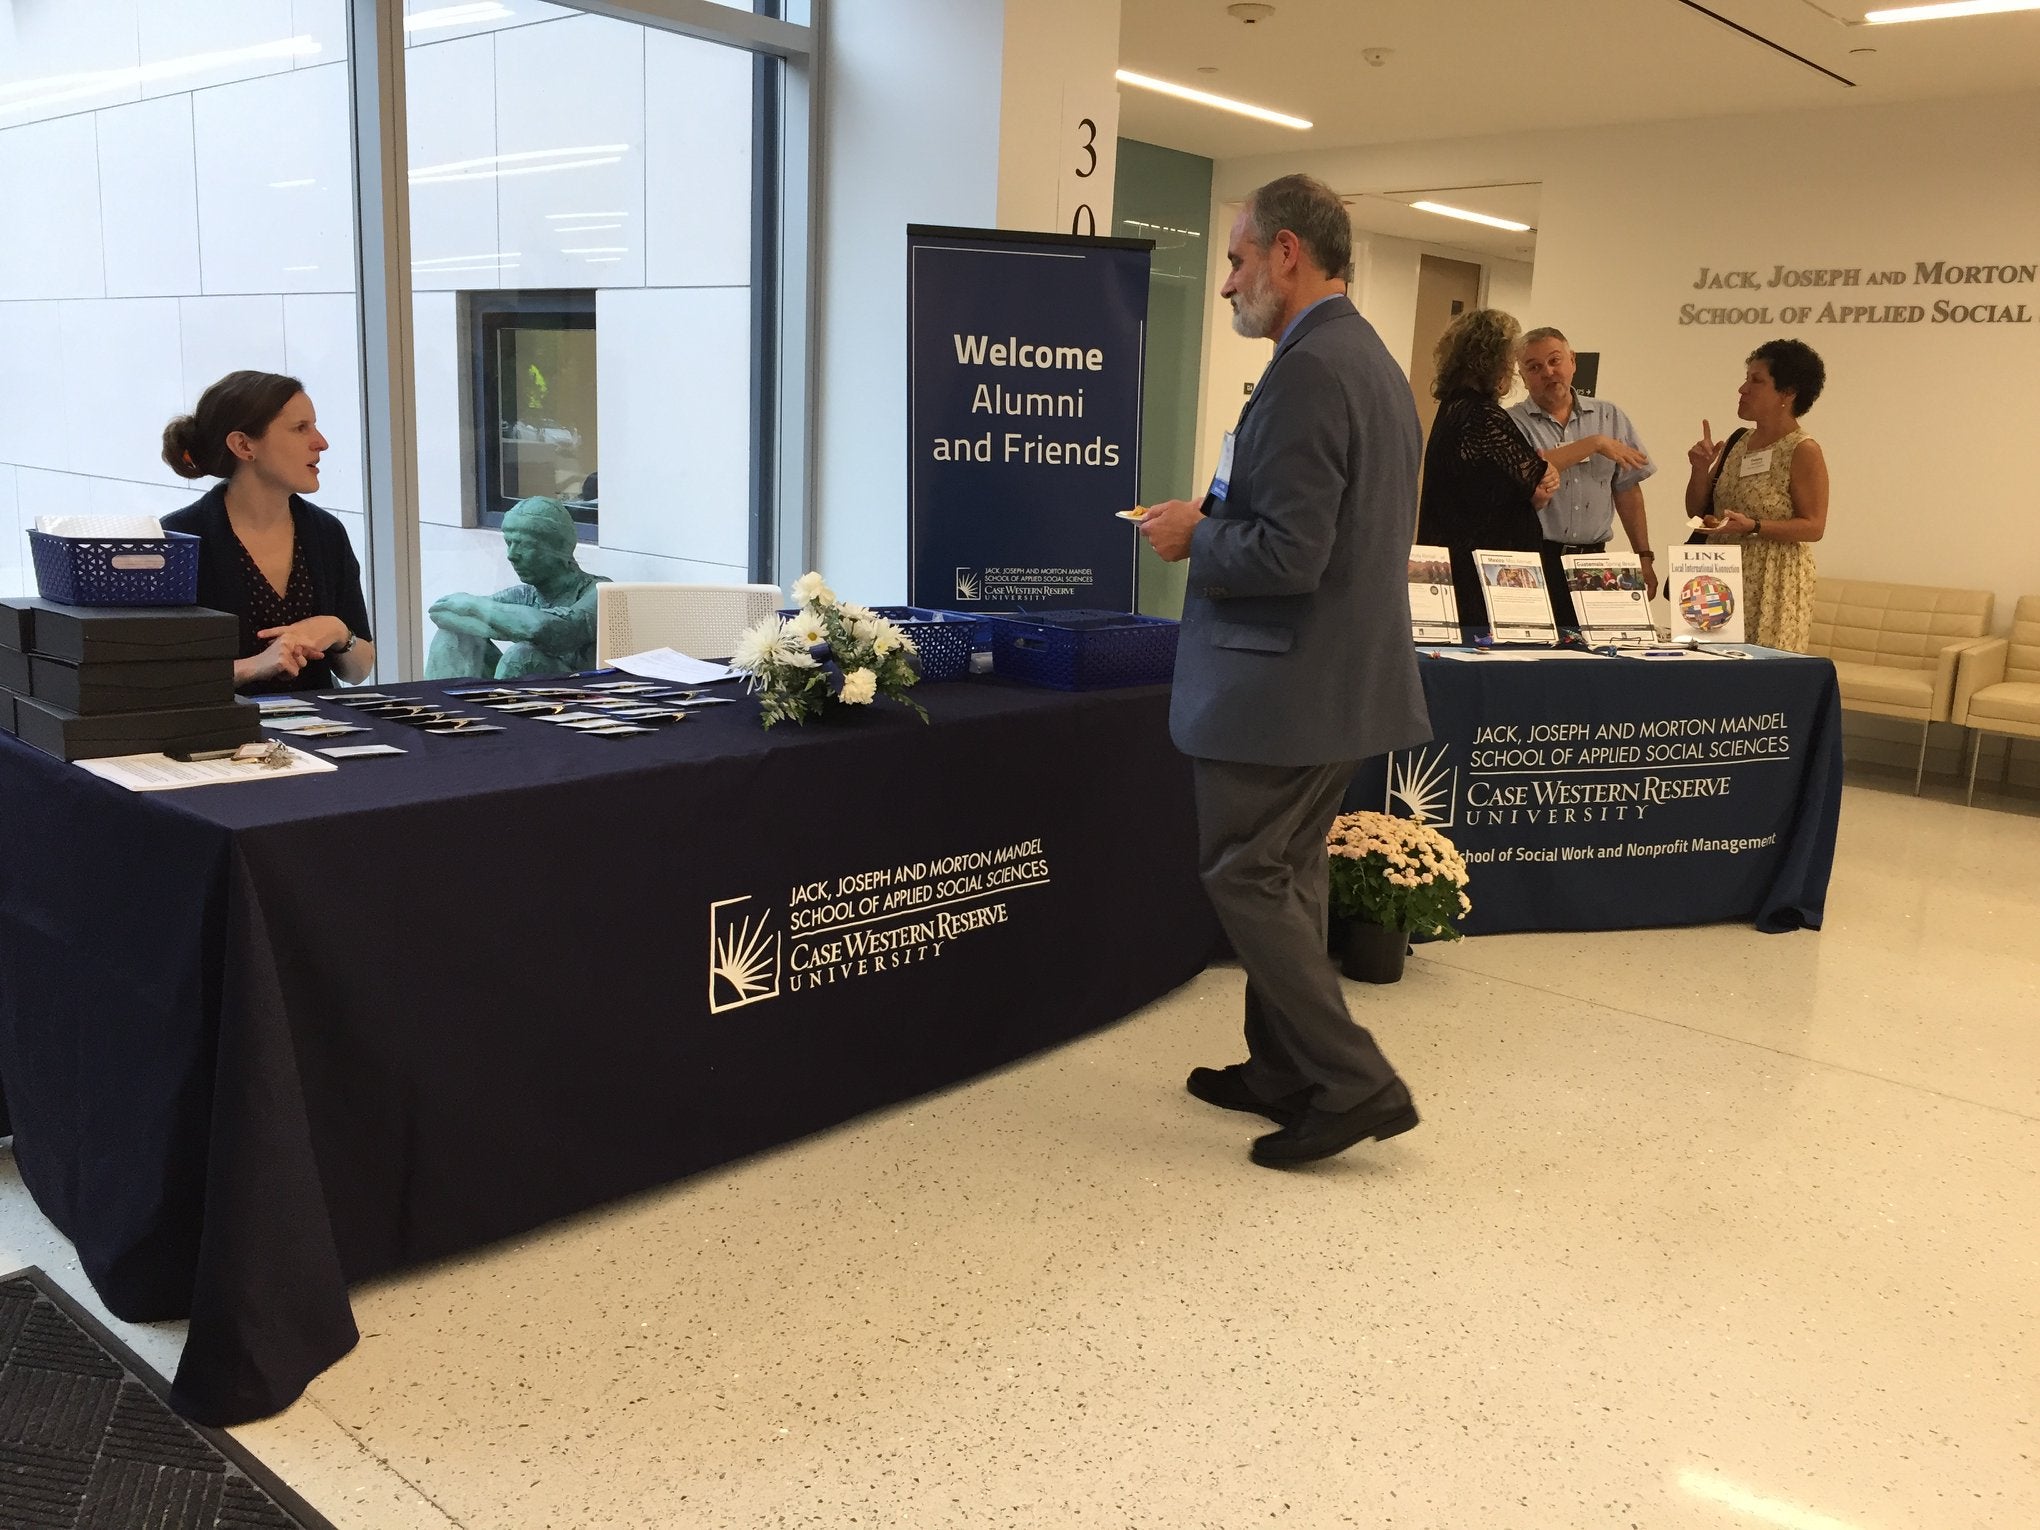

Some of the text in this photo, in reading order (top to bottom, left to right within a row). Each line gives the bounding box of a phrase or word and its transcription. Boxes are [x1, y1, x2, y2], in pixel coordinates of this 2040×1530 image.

[1693, 261, 2039, 291] JACK, JOSEPH AND MORTON
[1678, 300, 2033, 326] SCHOOL OF APPLIED SOCIAL
[953, 334, 1104, 371] Welcome
[971, 383, 1084, 418] Alumni
[933, 432, 1120, 467] and Friends
[1003, 567, 1025, 575] JOSEPH
[1026, 567, 1040, 575] AND
[1069, 568, 1092, 576] MANDEL
[1684, 552, 1726, 561] LINK
[984, 585, 1075, 597] CASE WESTERN RESERVE
[1021, 575, 1042, 583] APPLIED
[1473, 712, 1788, 745] JACK, JOSEPH AND MORTON MANDEL
[1470, 736, 1790, 768] SCHOOL OF APPLIED SOCIAL SCIENCES
[1467, 776, 1732, 807] CASE WESTERN RESERVE
[1466, 805, 1649, 826] UNIVERSITY
[1498, 847, 1513, 862] of
[1515, 846, 1558, 863] Social
[1561, 844, 1594, 860] Work
[1597, 843, 1623, 859] and
[1627, 840, 1688, 860] Nonprofit
[1692, 832, 1777, 854] Management
[789, 838, 1044, 907] JACK, JOSEPH AND MORTON MANDEL
[790, 860, 1049, 930] SCHOOL OF APPLIED SOCIAL SCIENCES
[791, 903, 1009, 972] CASE WESTERN RESERVE
[790, 941, 946, 993] UNIVERSITY
